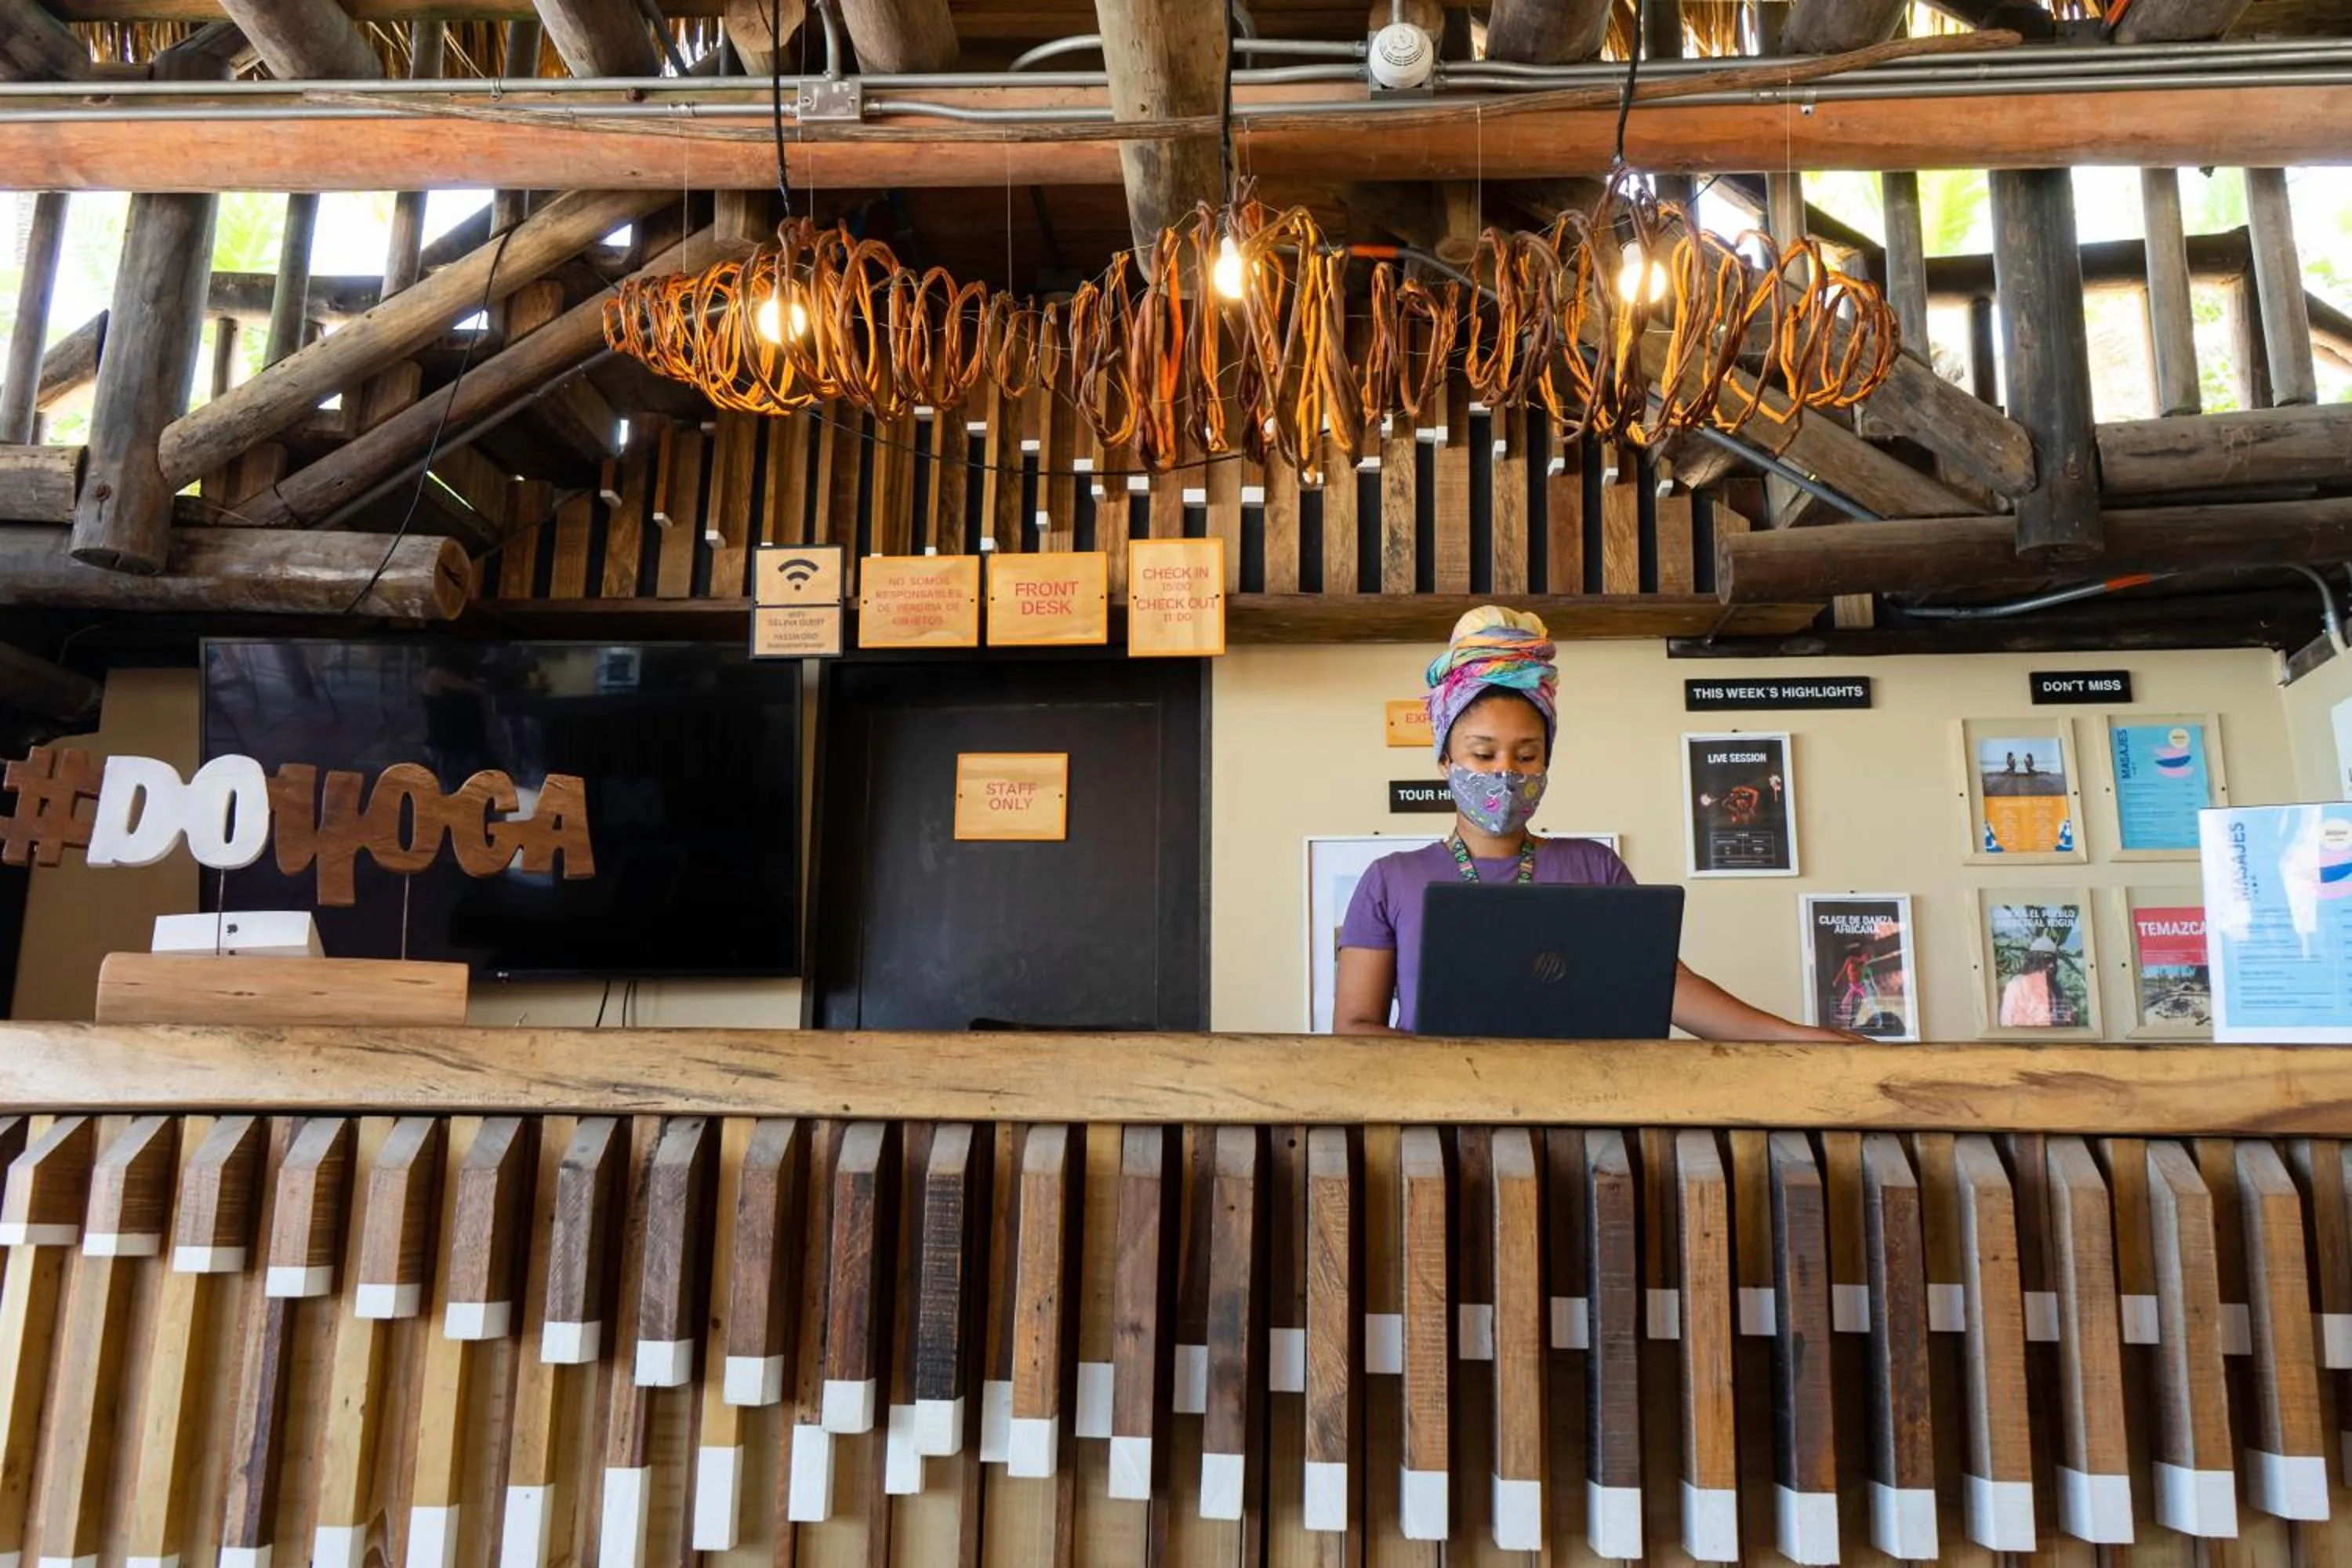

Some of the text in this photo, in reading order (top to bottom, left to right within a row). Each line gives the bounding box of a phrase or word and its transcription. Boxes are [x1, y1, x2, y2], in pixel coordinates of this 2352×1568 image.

[1142, 566, 1209, 579] CHECK IN
[889, 576, 950, 586] NO SOMOS
[876, 589, 963, 599] RESPONSABLES
[1015, 581, 1079, 597] FRONT
[877, 603, 891, 612] DE
[1021, 600, 1073, 615] DESK
[1137, 597, 1217, 611] CHECK OUT
[1693, 688, 1724, 699] THIS
[1782, 685, 1864, 699] HIGHLIGHTS
[2042, 679, 2122, 694] DON'T MISS
[1708, 753, 1767, 764] LIVE SESSION
[2117, 728, 2132, 779] MASAJES
[985, 782, 1038, 796] STAFF
[1398, 789, 1435, 800] TOUR
[989, 797, 1034, 810] ONLY
